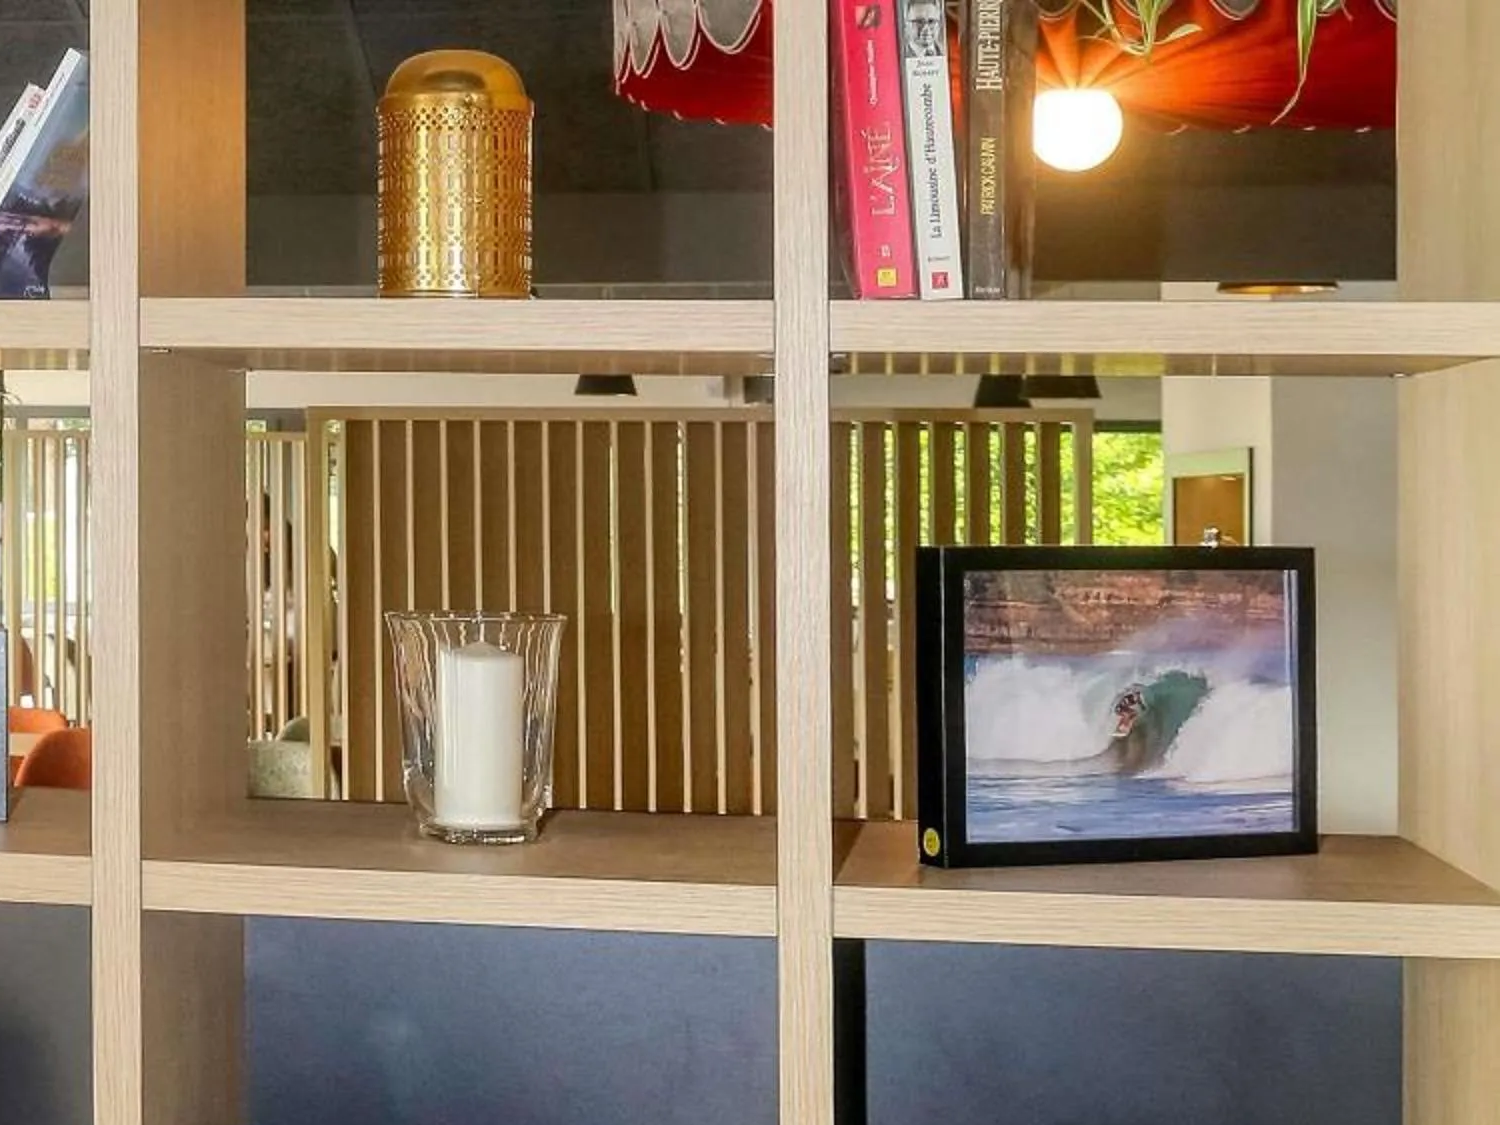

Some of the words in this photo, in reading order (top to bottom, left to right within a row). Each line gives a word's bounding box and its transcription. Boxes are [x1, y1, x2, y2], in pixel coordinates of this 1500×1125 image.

[976, 0, 1003, 90] HAUTE-PIERR
[927, 168, 941, 224] Limousine
[930, 225, 942, 239] La
